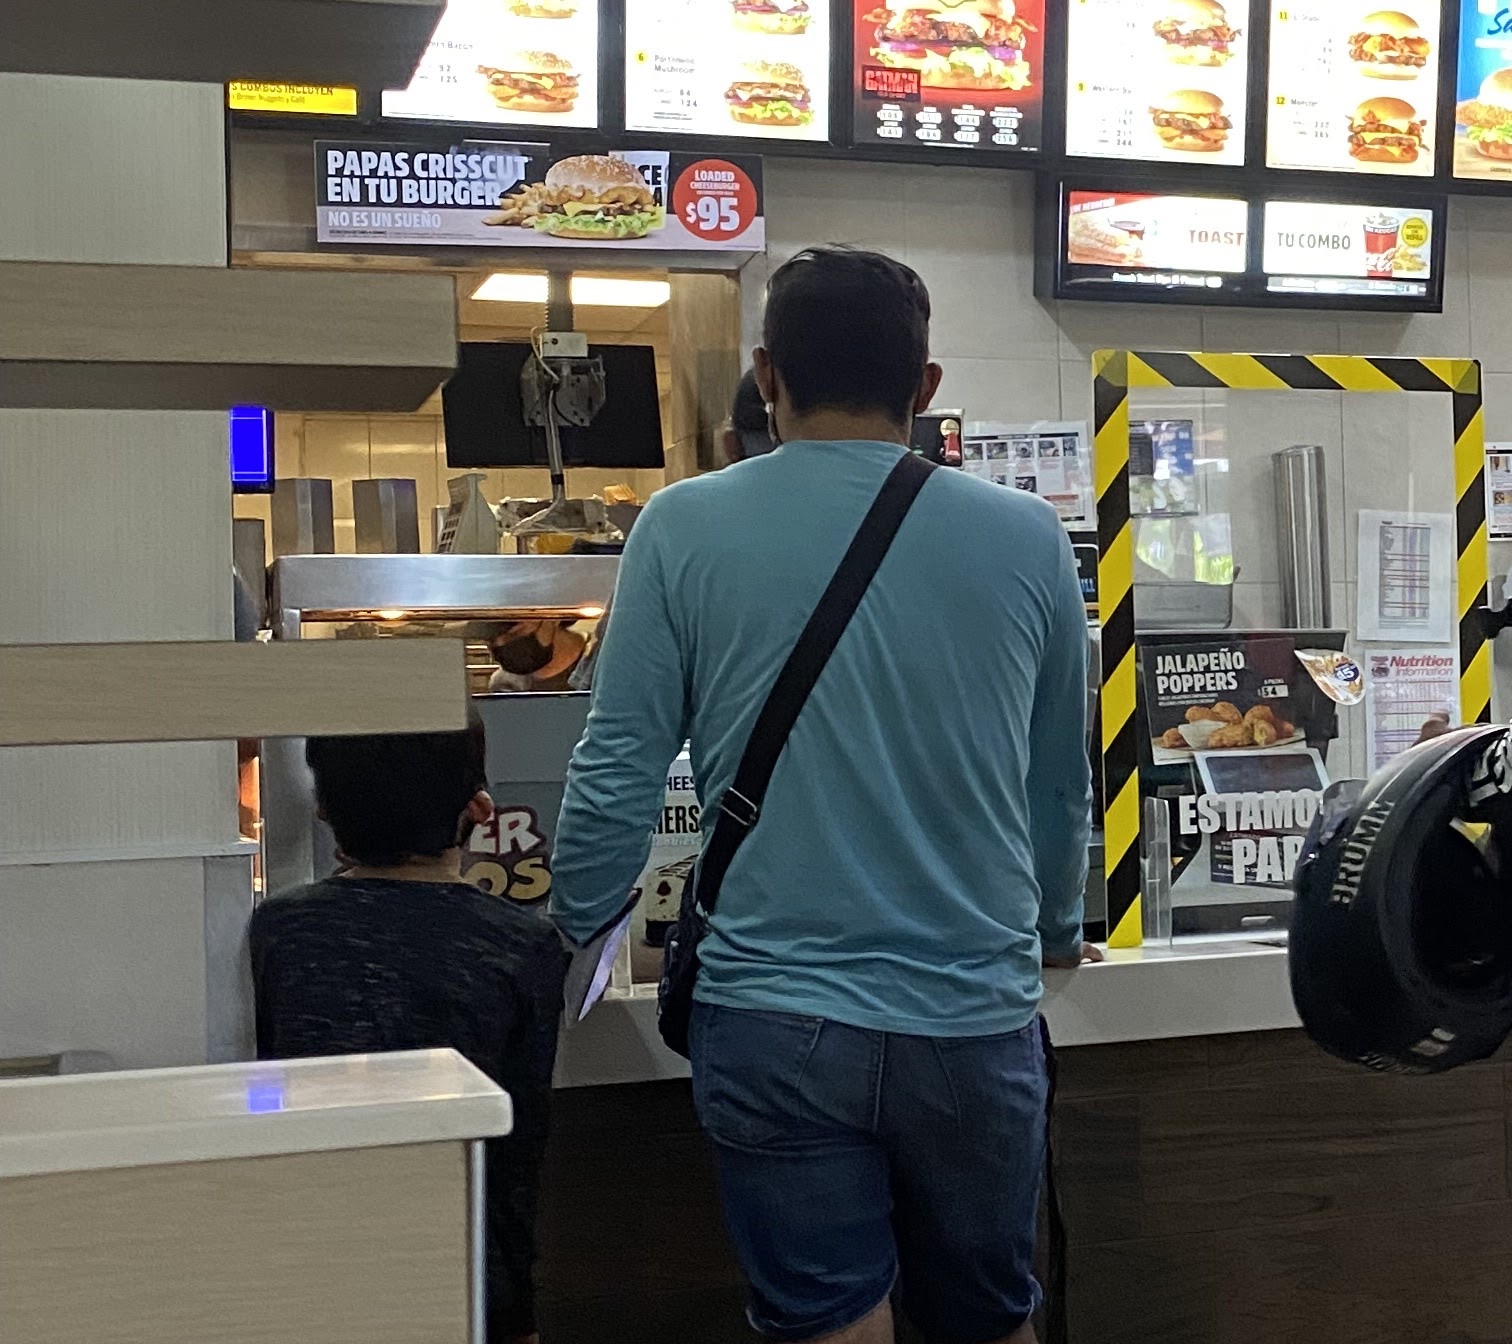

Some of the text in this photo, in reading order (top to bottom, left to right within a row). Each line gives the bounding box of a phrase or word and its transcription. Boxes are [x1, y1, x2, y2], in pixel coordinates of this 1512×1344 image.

[327, 150, 530, 183] PAPAS CRISSCUT
[694, 169, 736, 182] LOADED
[327, 178, 502, 207] EN TU BURGER
[327, 210, 442, 230] NO ES UN SUEÑO
[685, 195, 741, 232] $95
[1188, 229, 1245, 247] TOAST
[1277, 231, 1351, 250] TU COMBO
[1154, 647, 1246, 676] JALAPEÑO
[1389, 654, 1454, 668] Nutrition
[1156, 671, 1239, 695] POPPERS
[1178, 788, 1323, 836] ESTAMO
